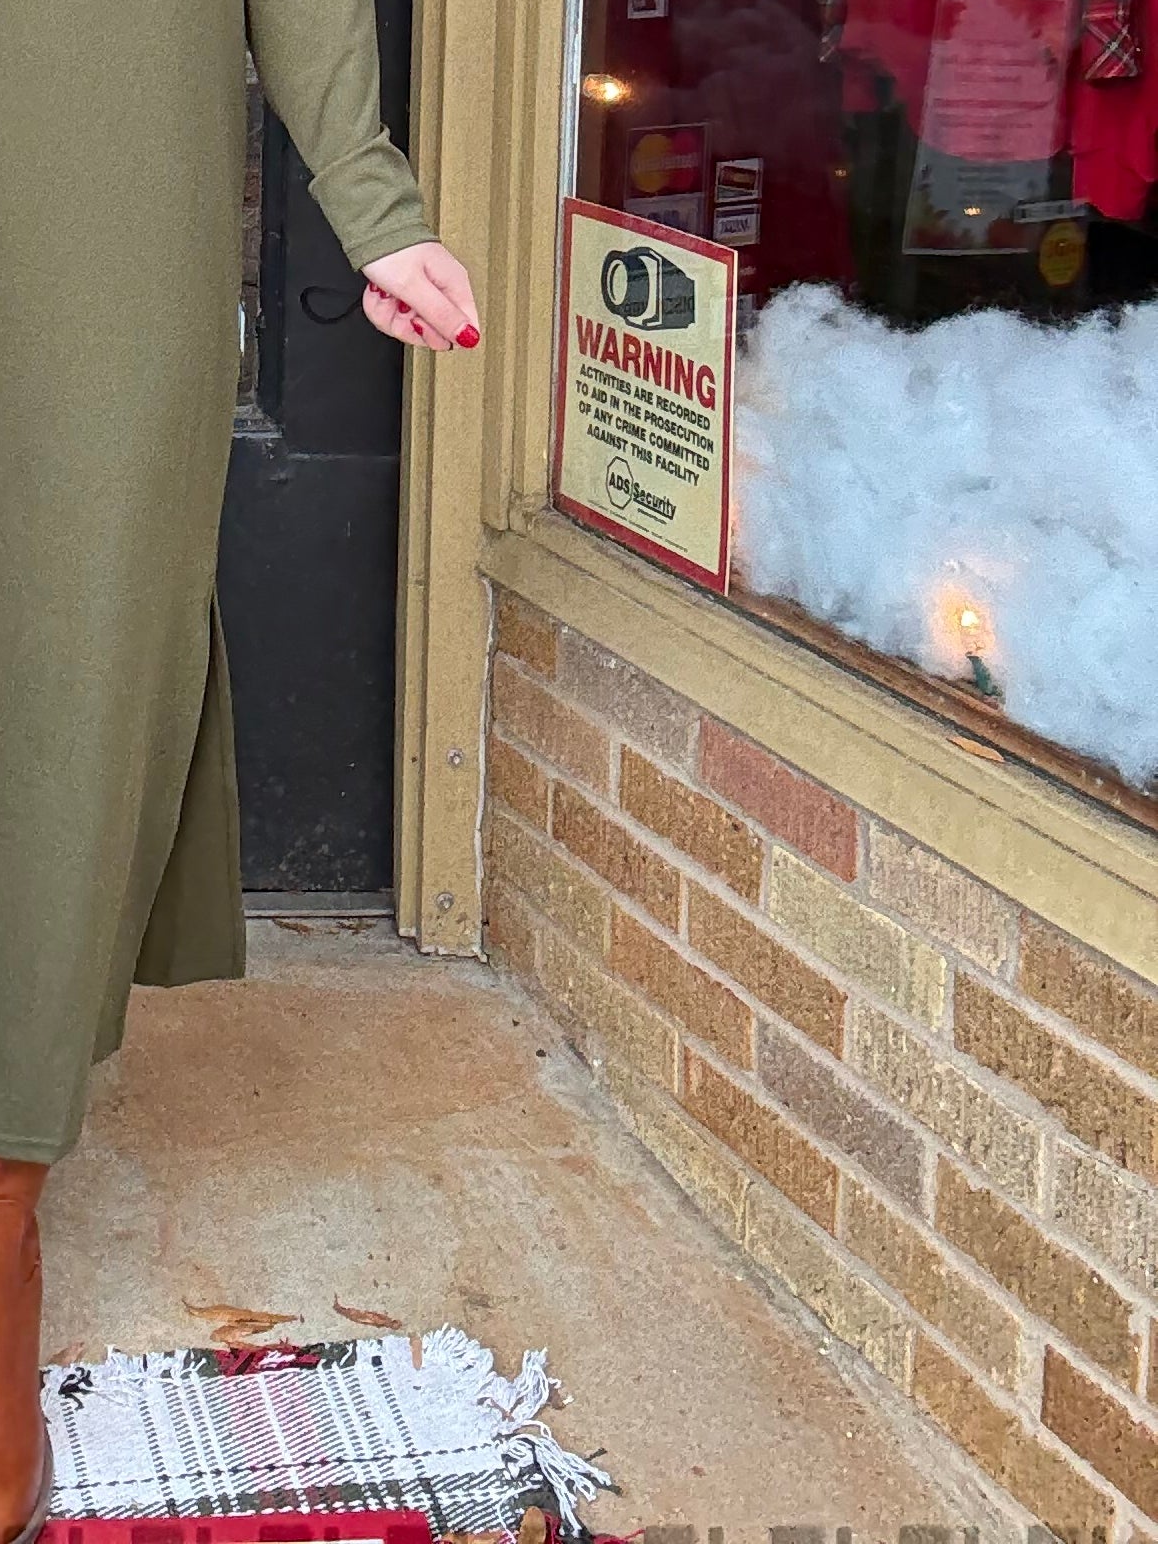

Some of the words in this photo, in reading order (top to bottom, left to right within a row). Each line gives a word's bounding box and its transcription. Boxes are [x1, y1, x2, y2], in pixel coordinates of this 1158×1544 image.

[576, 314, 716, 411] WARNING
[580, 363, 632, 395] ACTIVITIES
[633, 386, 654, 405] ARE
[655, 394, 711, 431] RECORDED
[576, 380, 589, 396] TO
[591, 387, 608, 404] AID
[610, 394, 620, 411] IN
[623, 400, 641, 419] THE
[644, 410, 714, 454] PROSECUTION
[578, 400, 592, 416] OF
[593, 407, 614, 426] ANY
[615, 416, 647, 443] CRIME
[649, 432, 710, 471] COMMITTED
[587, 424, 629, 453] AGAINST
[631, 442, 653, 465] THIS
[655, 454, 700, 486] FACILITY
[609, 472, 630, 495] ADS
[633, 482, 677, 519] Security
